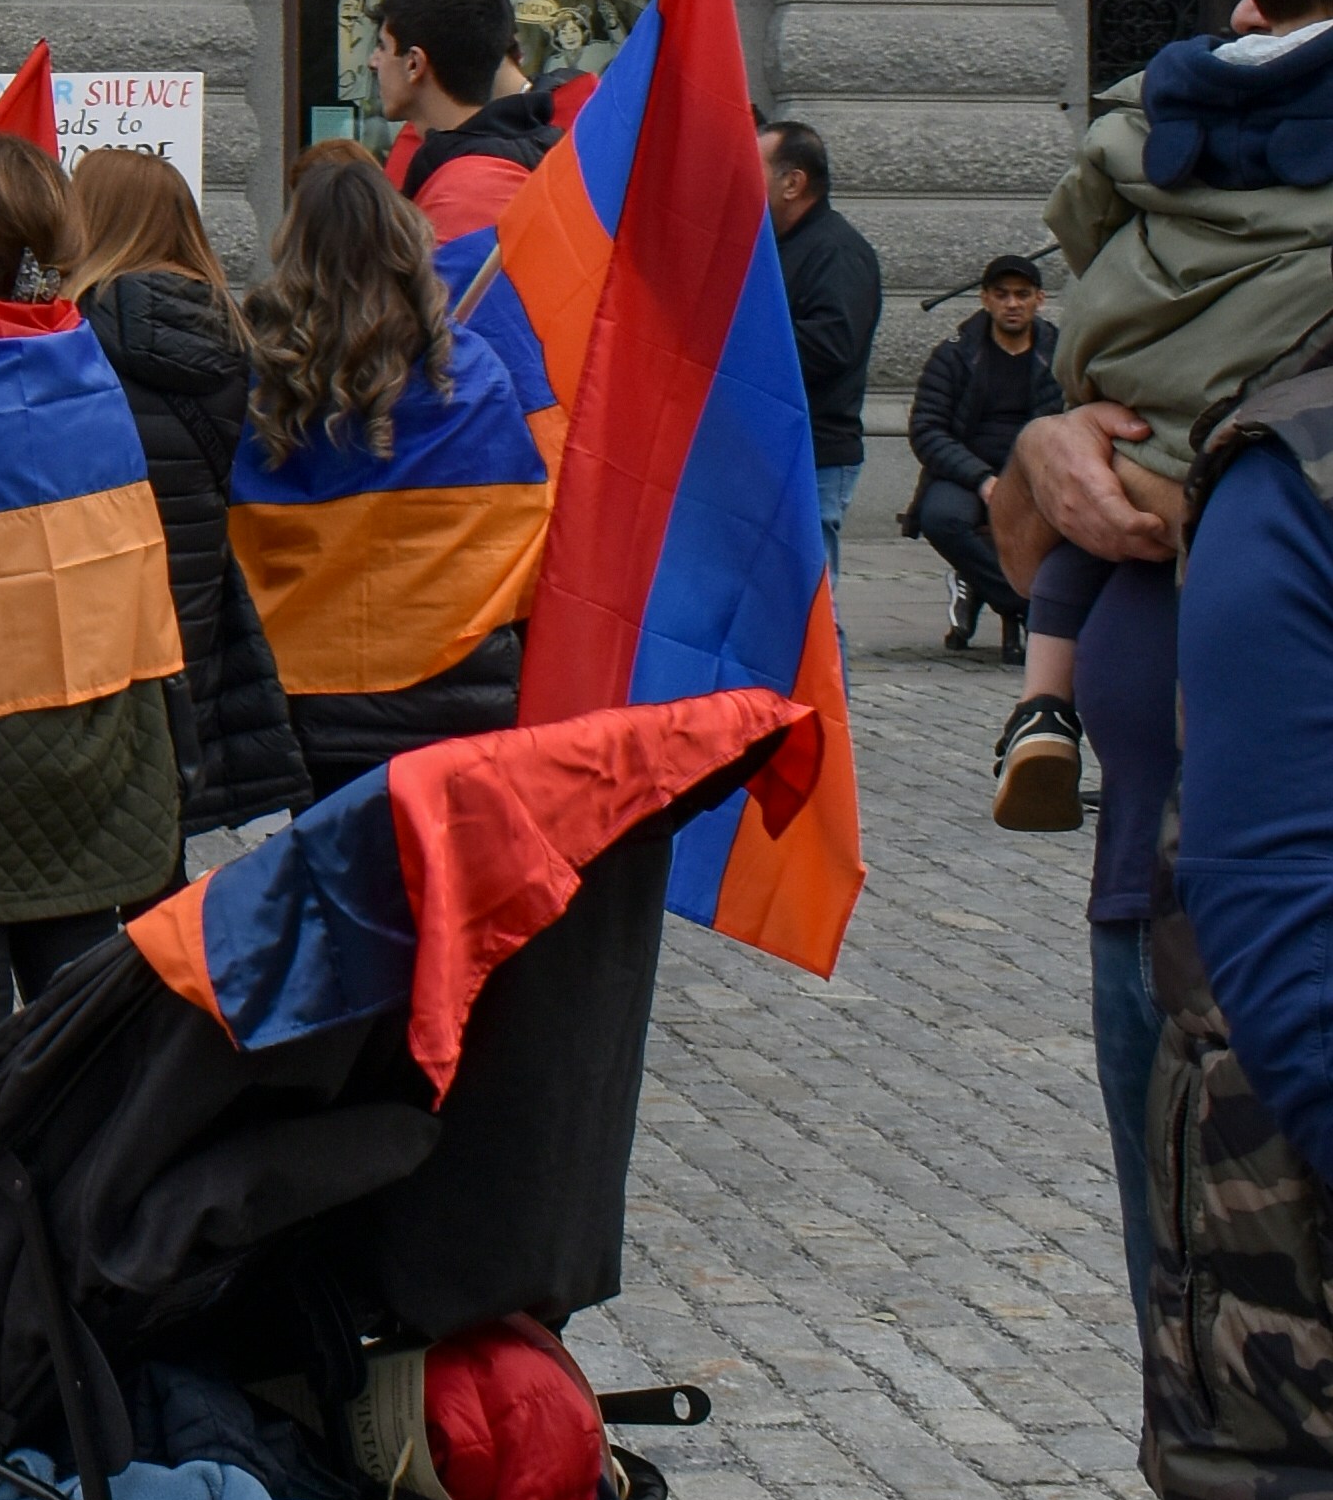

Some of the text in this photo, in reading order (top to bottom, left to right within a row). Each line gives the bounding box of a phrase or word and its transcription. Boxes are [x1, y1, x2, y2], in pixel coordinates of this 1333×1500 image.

[84, 78, 195, 109] SILENCE
[56, 109, 143, 136] ads to
[356, 1393, 385, 1479] VINTAG
